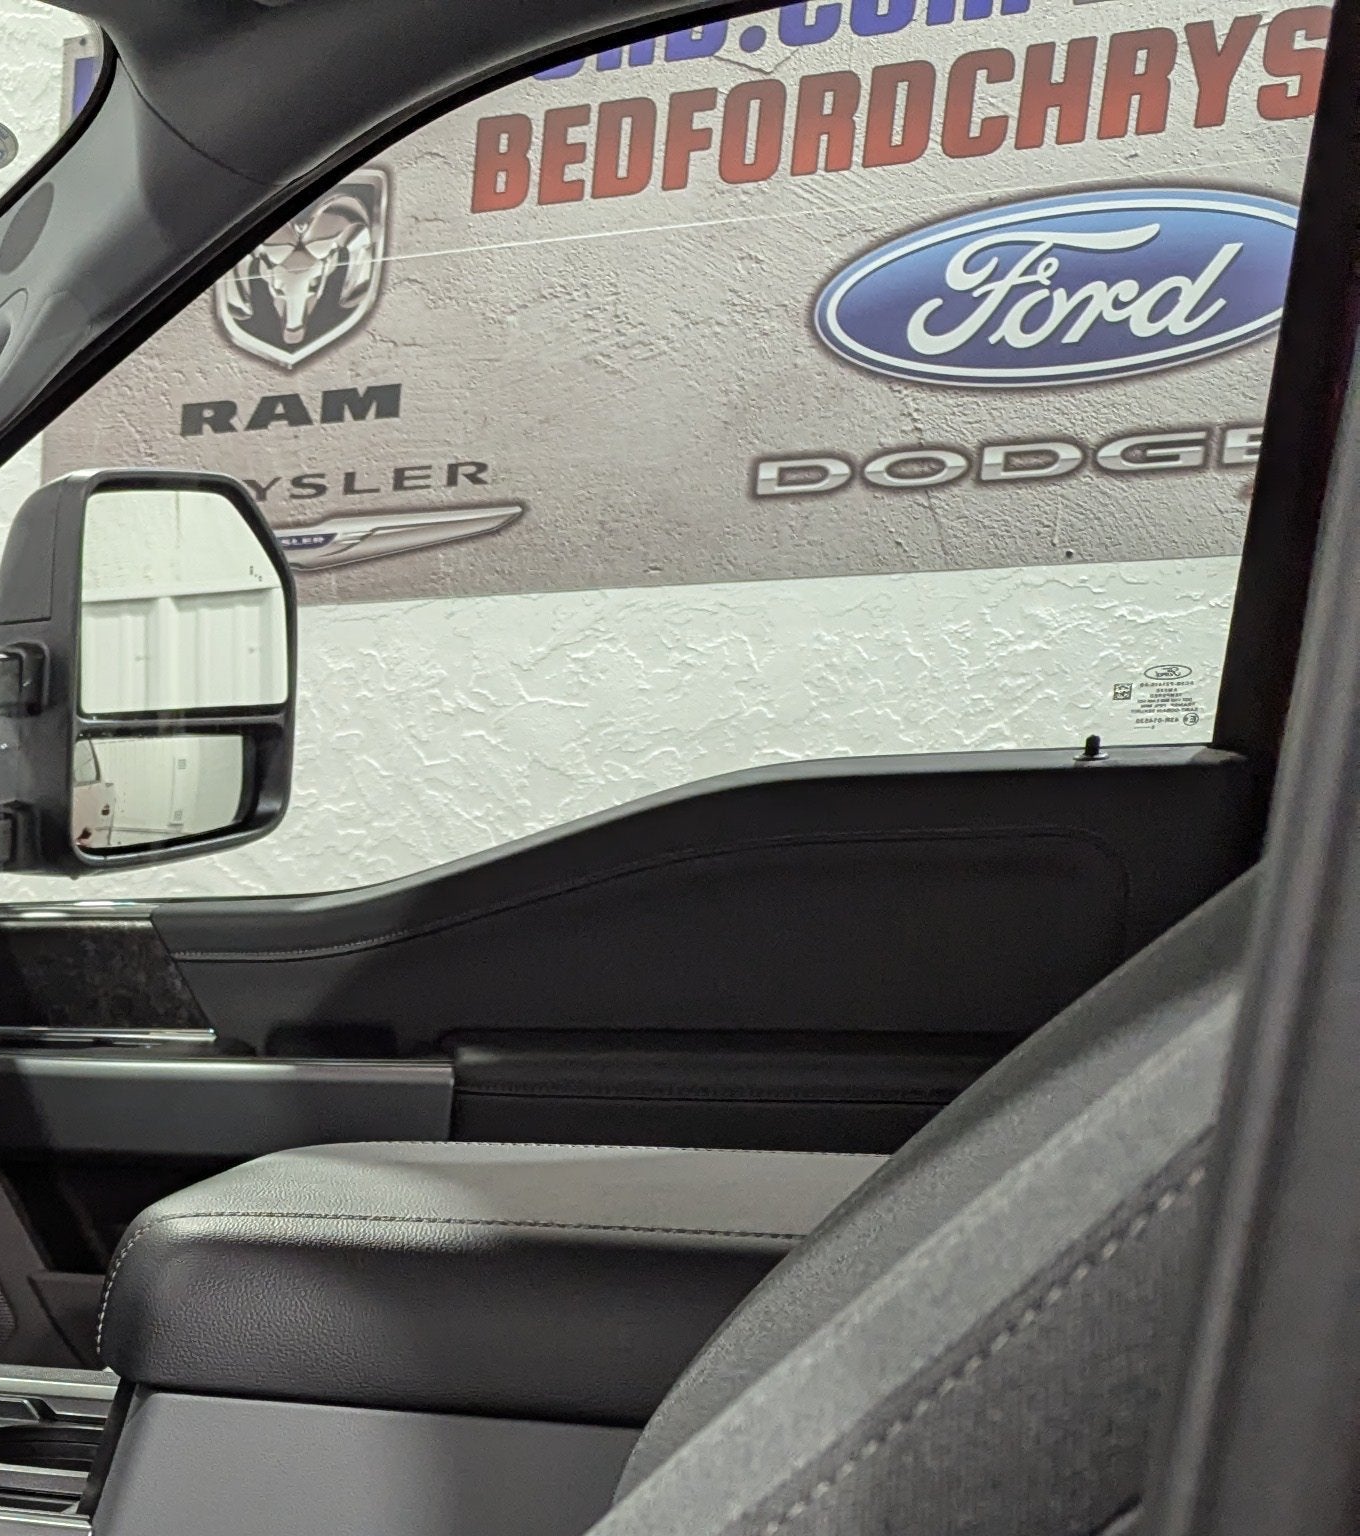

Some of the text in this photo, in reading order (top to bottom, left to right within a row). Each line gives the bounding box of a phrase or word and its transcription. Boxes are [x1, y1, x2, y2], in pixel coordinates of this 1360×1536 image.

[471, 5, 1334, 213] BEDFORDCHRYS
[907, 223, 1244, 356] Ford
[180, 383, 402, 437] RAM
